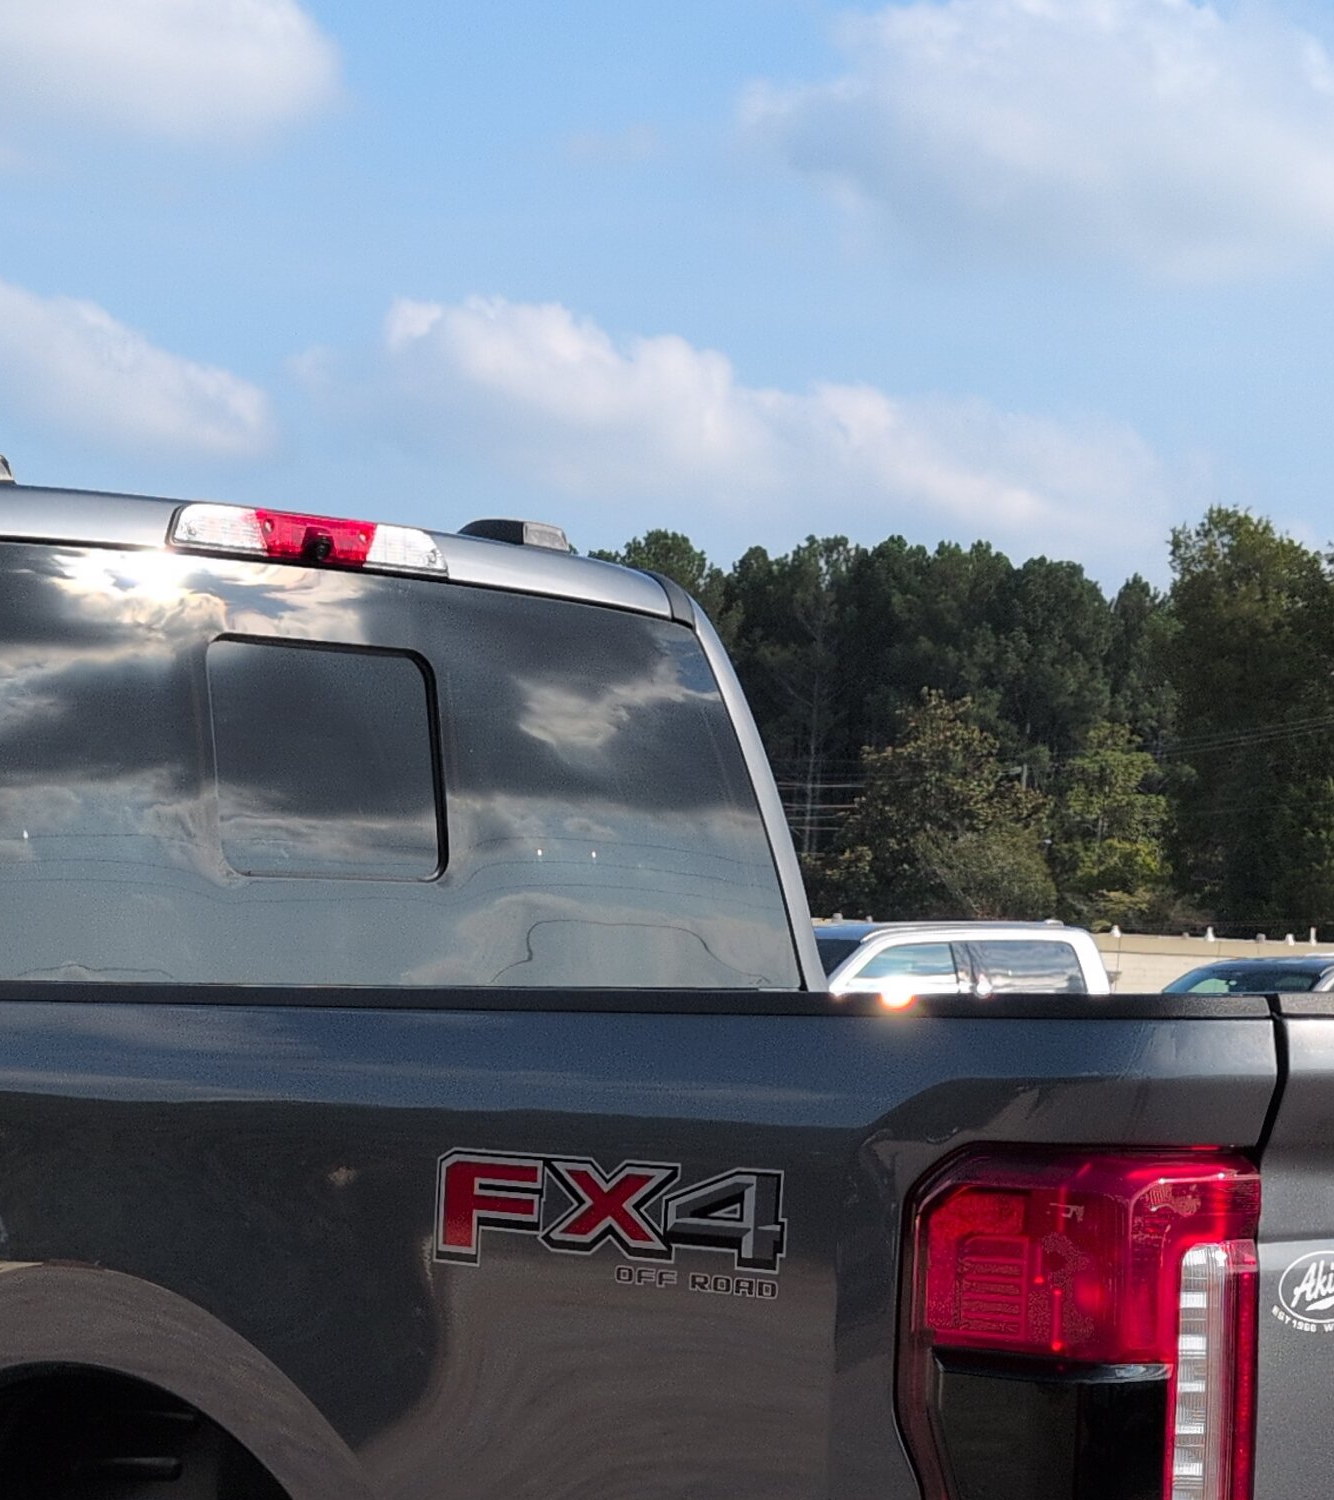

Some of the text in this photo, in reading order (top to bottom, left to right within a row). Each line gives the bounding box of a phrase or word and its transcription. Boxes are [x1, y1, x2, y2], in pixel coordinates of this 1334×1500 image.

[433, 1147, 786, 1274] FX4
[615, 1265, 778, 1299] OFF ROAD
[1272, 1305, 1291, 1324] EST
